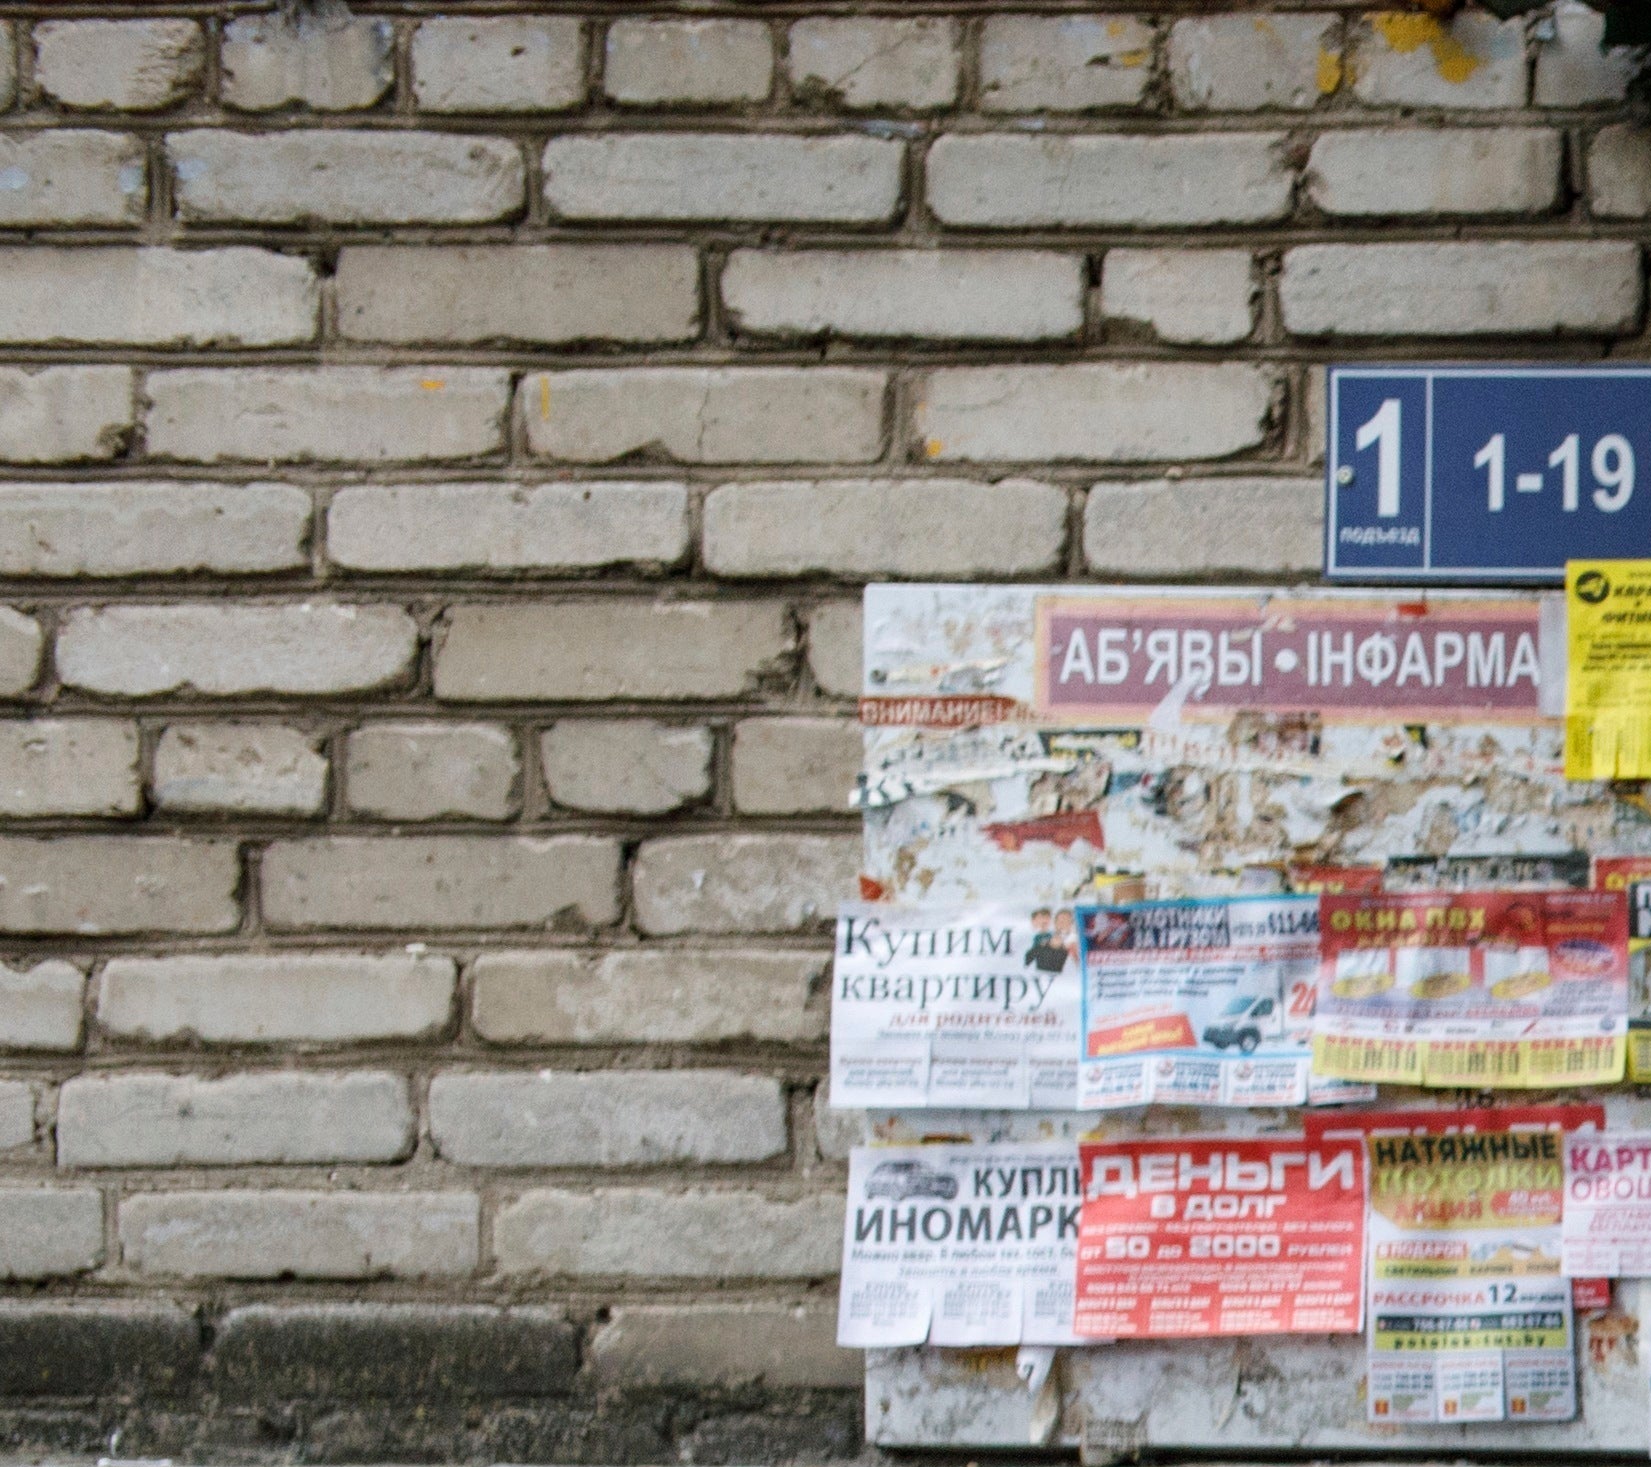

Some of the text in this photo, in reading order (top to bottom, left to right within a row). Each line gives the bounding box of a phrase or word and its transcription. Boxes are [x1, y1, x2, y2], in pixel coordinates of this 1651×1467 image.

[1356, 398, 1401, 518] 1
[1473, 433, 1637, 513] 1-19
[842, 917, 1013, 968] Купим
[840, 970, 1058, 1012] квартиру
[1375, 1133, 1557, 1165] НАТЯЖНЫЕ
[1085, 1151, 1355, 1200] ДЕНЬГИ
[1377, 1164, 1562, 1194] ПОТОЛКИ
[1183, 1194, 1288, 1222] ДОЛГ
[1105, 1235, 1151, 1260] 50
[1372, 1291, 1485, 1307] РАССРОЧКА
[1487, 1282, 1519, 1304] 12
